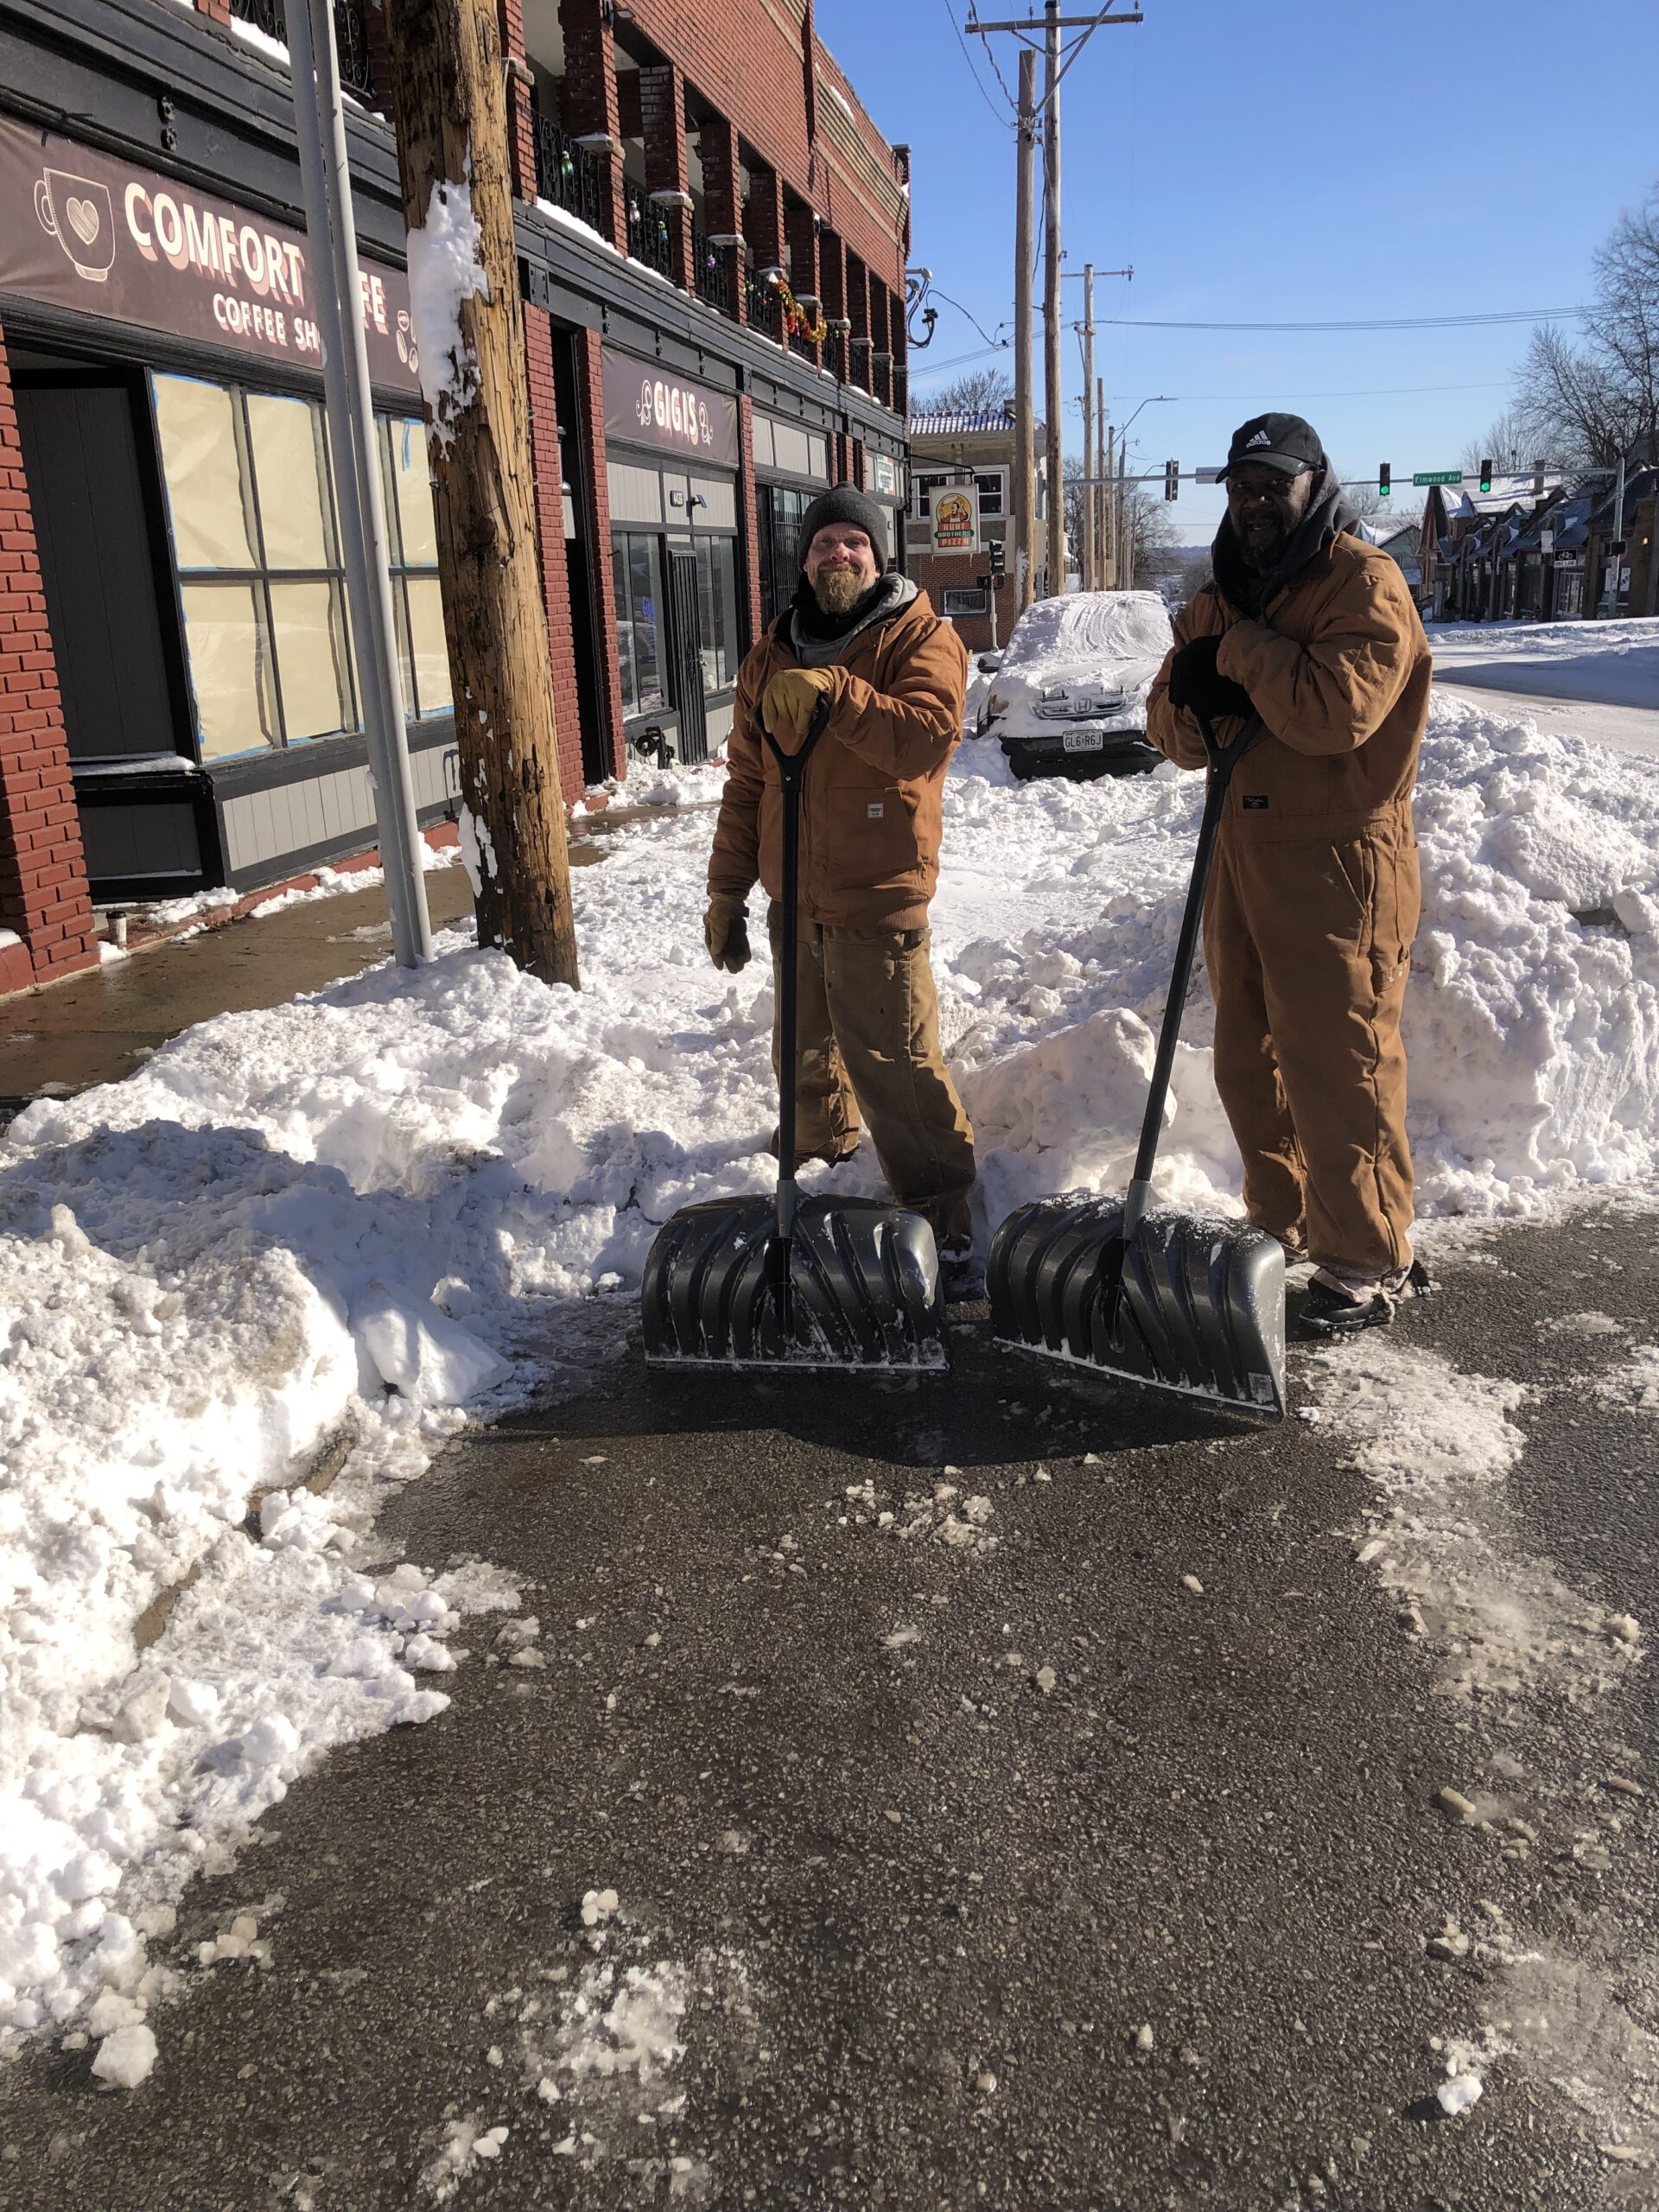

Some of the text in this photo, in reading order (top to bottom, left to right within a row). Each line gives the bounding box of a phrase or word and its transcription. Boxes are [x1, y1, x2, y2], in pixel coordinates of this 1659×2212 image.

[124, 182, 387, 327] COMFORT FE
[213, 293, 320, 350] COFFEE SH
[654, 381, 697, 438] GIGI'S
[1246, 439, 1271, 448] adidas
[1414, 475, 1445, 484] Elmwood
[942, 537, 969, 546] PIZZA
